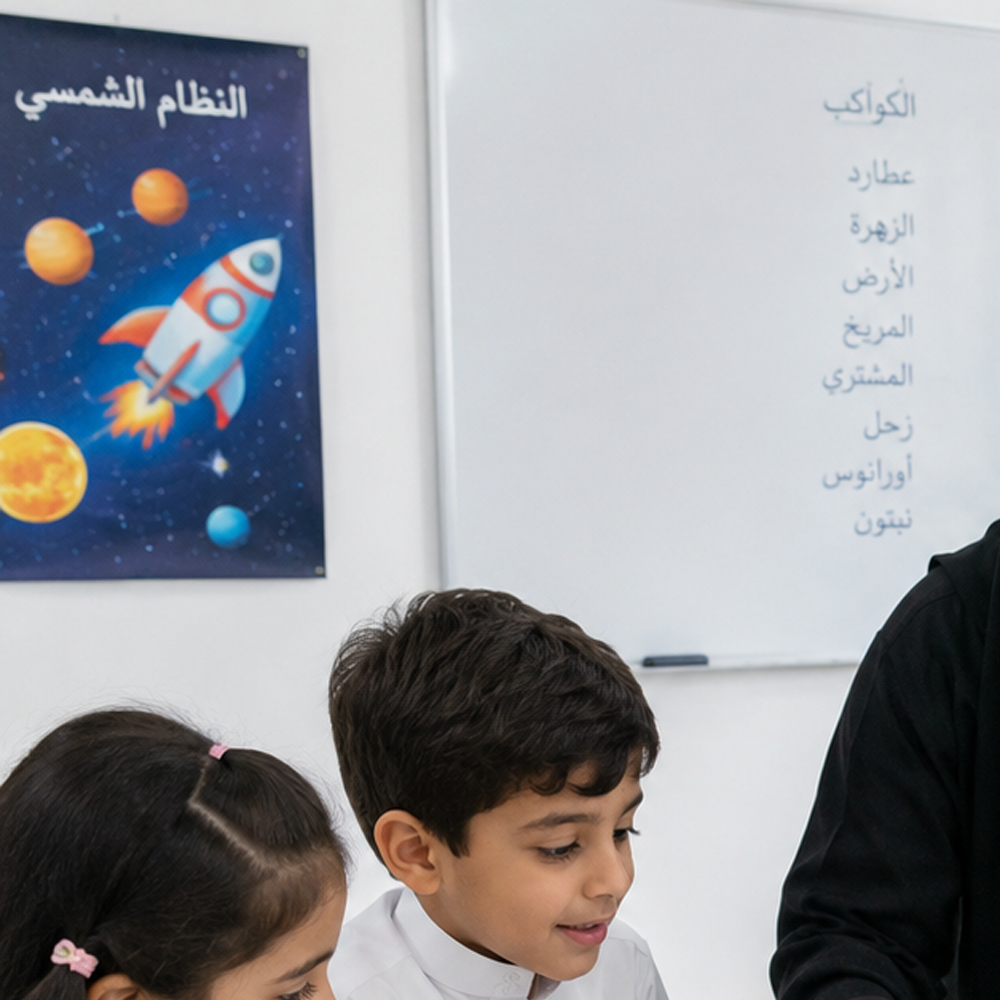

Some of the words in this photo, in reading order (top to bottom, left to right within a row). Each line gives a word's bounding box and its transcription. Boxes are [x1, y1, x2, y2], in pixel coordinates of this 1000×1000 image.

[15, 75, 145, 121] الشمسي
[157, 79, 247, 128] النظام
[848, 159, 915, 192] عطارد
[850, 212, 914, 246] الزهرة
[842, 257, 914, 296] الأرض
[842, 313, 914, 350] المريخ
[821, 361, 913, 396] المشتري
[863, 409, 914, 443] زحل
[821, 452, 913, 492] أورانوس
[853, 508, 913, 538] نبتون
